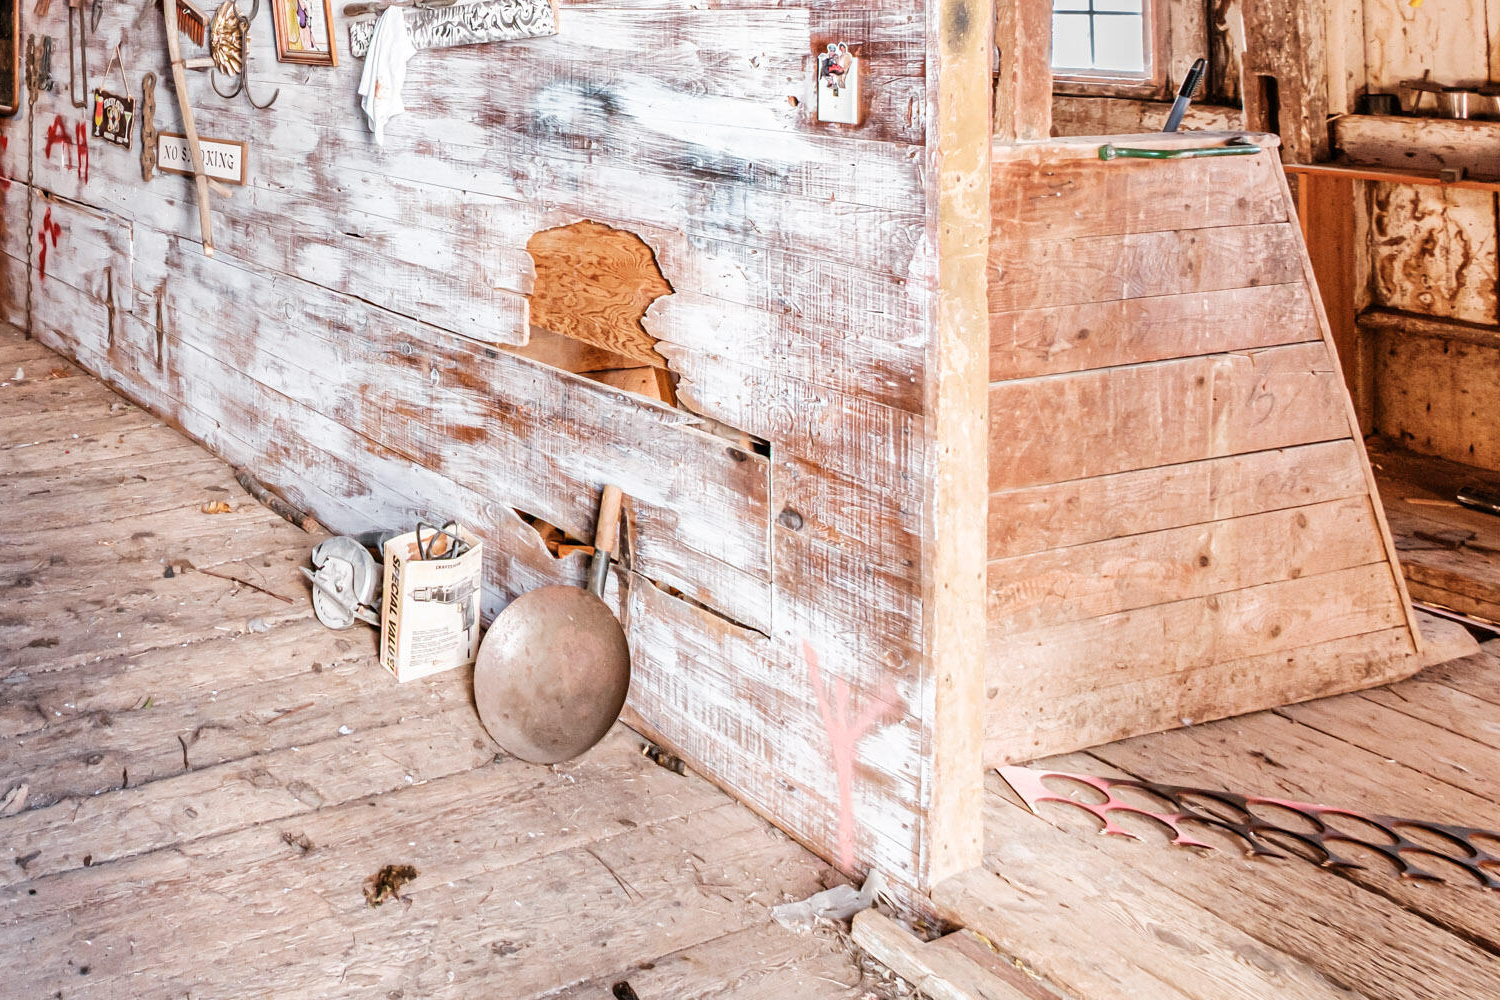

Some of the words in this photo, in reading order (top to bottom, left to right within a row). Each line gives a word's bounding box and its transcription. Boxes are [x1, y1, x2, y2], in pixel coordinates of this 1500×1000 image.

[164, 145, 178, 160] NO
[182, 146, 234, 170] SOKING
[389, 554, 401, 616] SPECIAL
